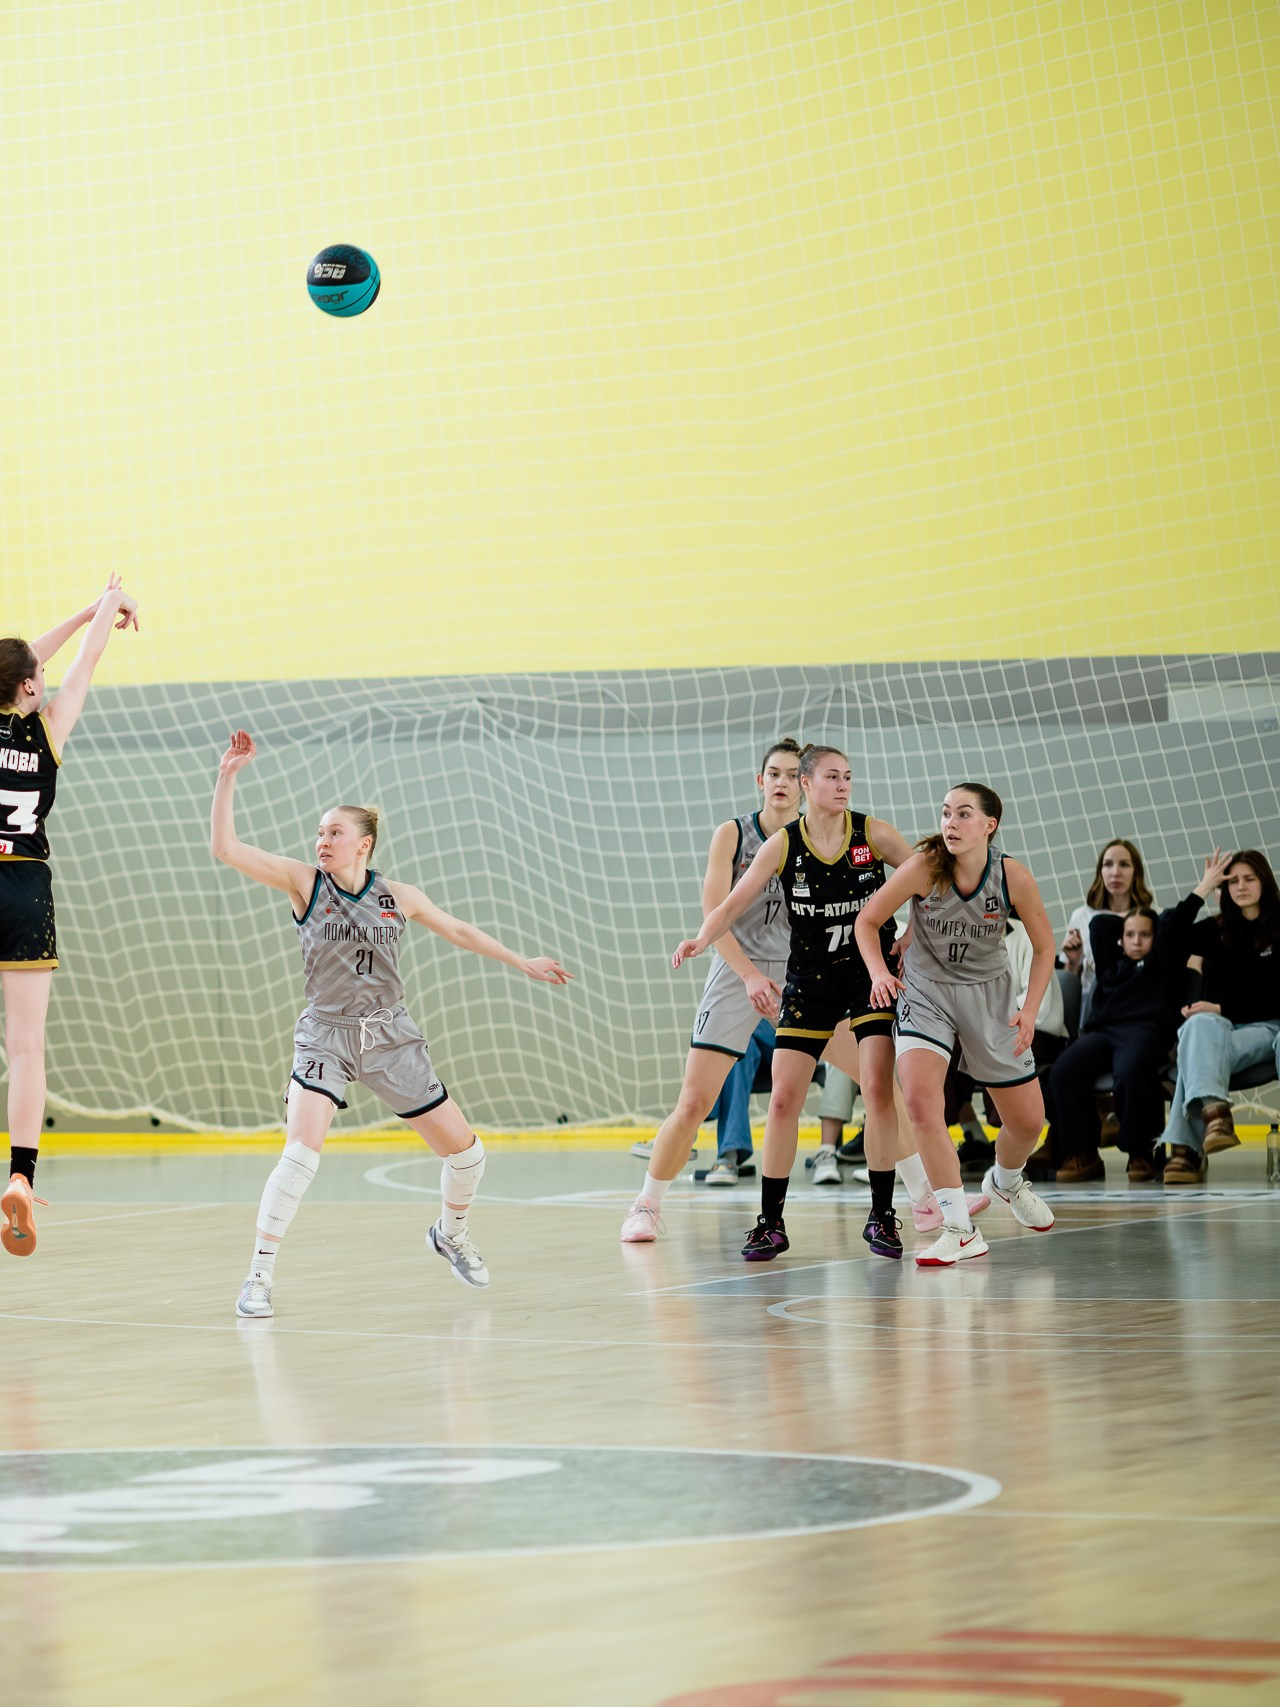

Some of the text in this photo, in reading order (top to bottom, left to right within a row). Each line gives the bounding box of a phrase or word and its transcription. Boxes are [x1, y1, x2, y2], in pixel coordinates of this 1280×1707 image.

[853, 846, 870, 856] FON
[855, 853, 871, 863] BET
[764, 900, 782, 925] 17
[791, 888, 878, 917] ЧГУ-АТЛАН
[324, 922, 398, 945] ПОЛИТЕХ ПЕТРА
[970, 923, 998, 938] ПЕТРА
[355, 949, 374, 976] 21
[948, 943, 970, 964] 97
[304, 1060, 325, 1080] 21
